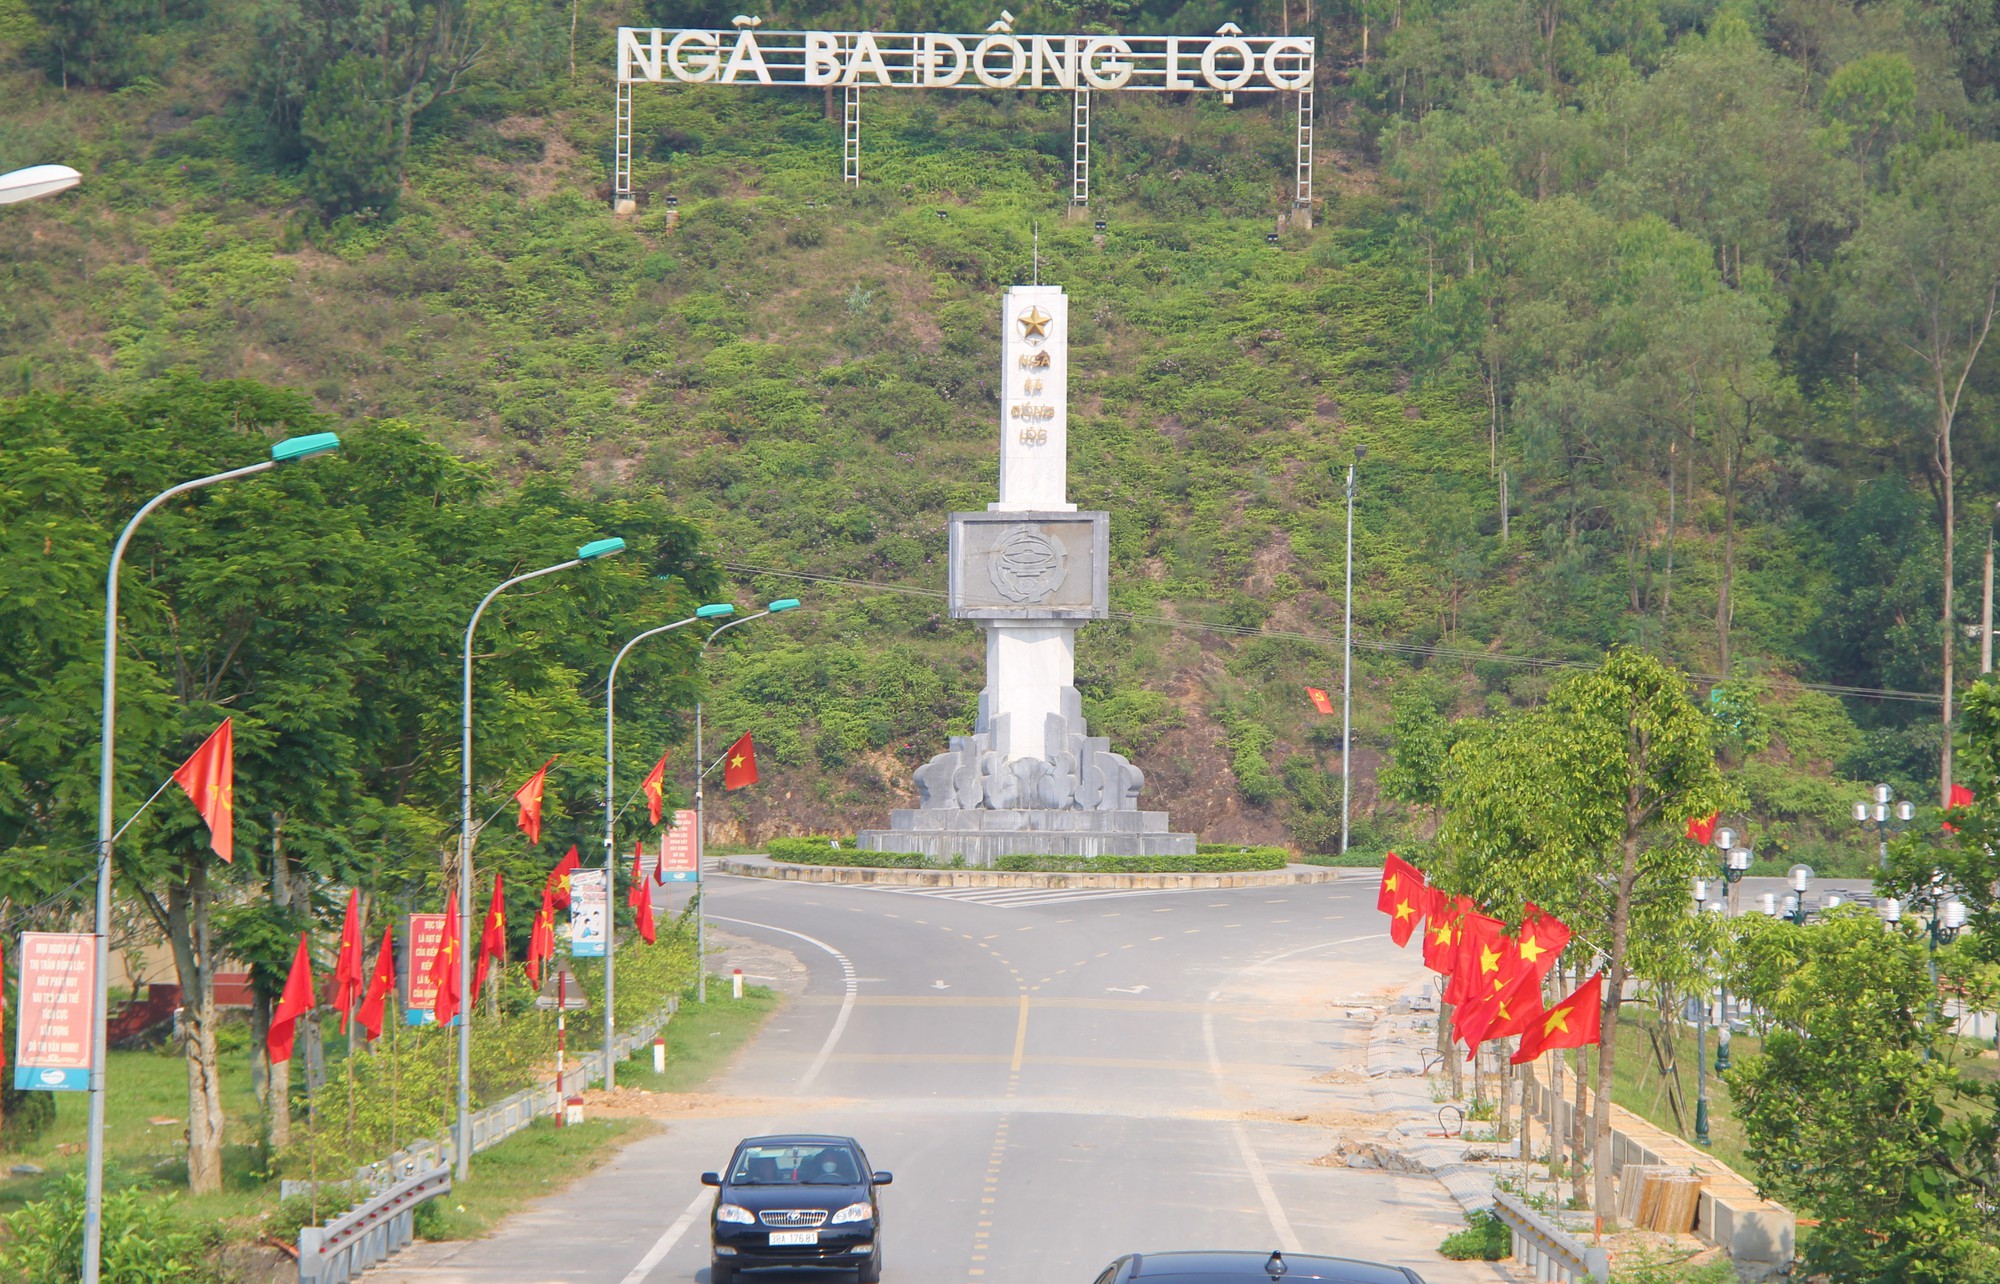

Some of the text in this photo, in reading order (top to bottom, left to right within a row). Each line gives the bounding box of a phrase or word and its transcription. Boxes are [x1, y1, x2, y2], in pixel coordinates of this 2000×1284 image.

[618, 9, 1315, 104] NGÃ BA ĐỒNG LỘC
